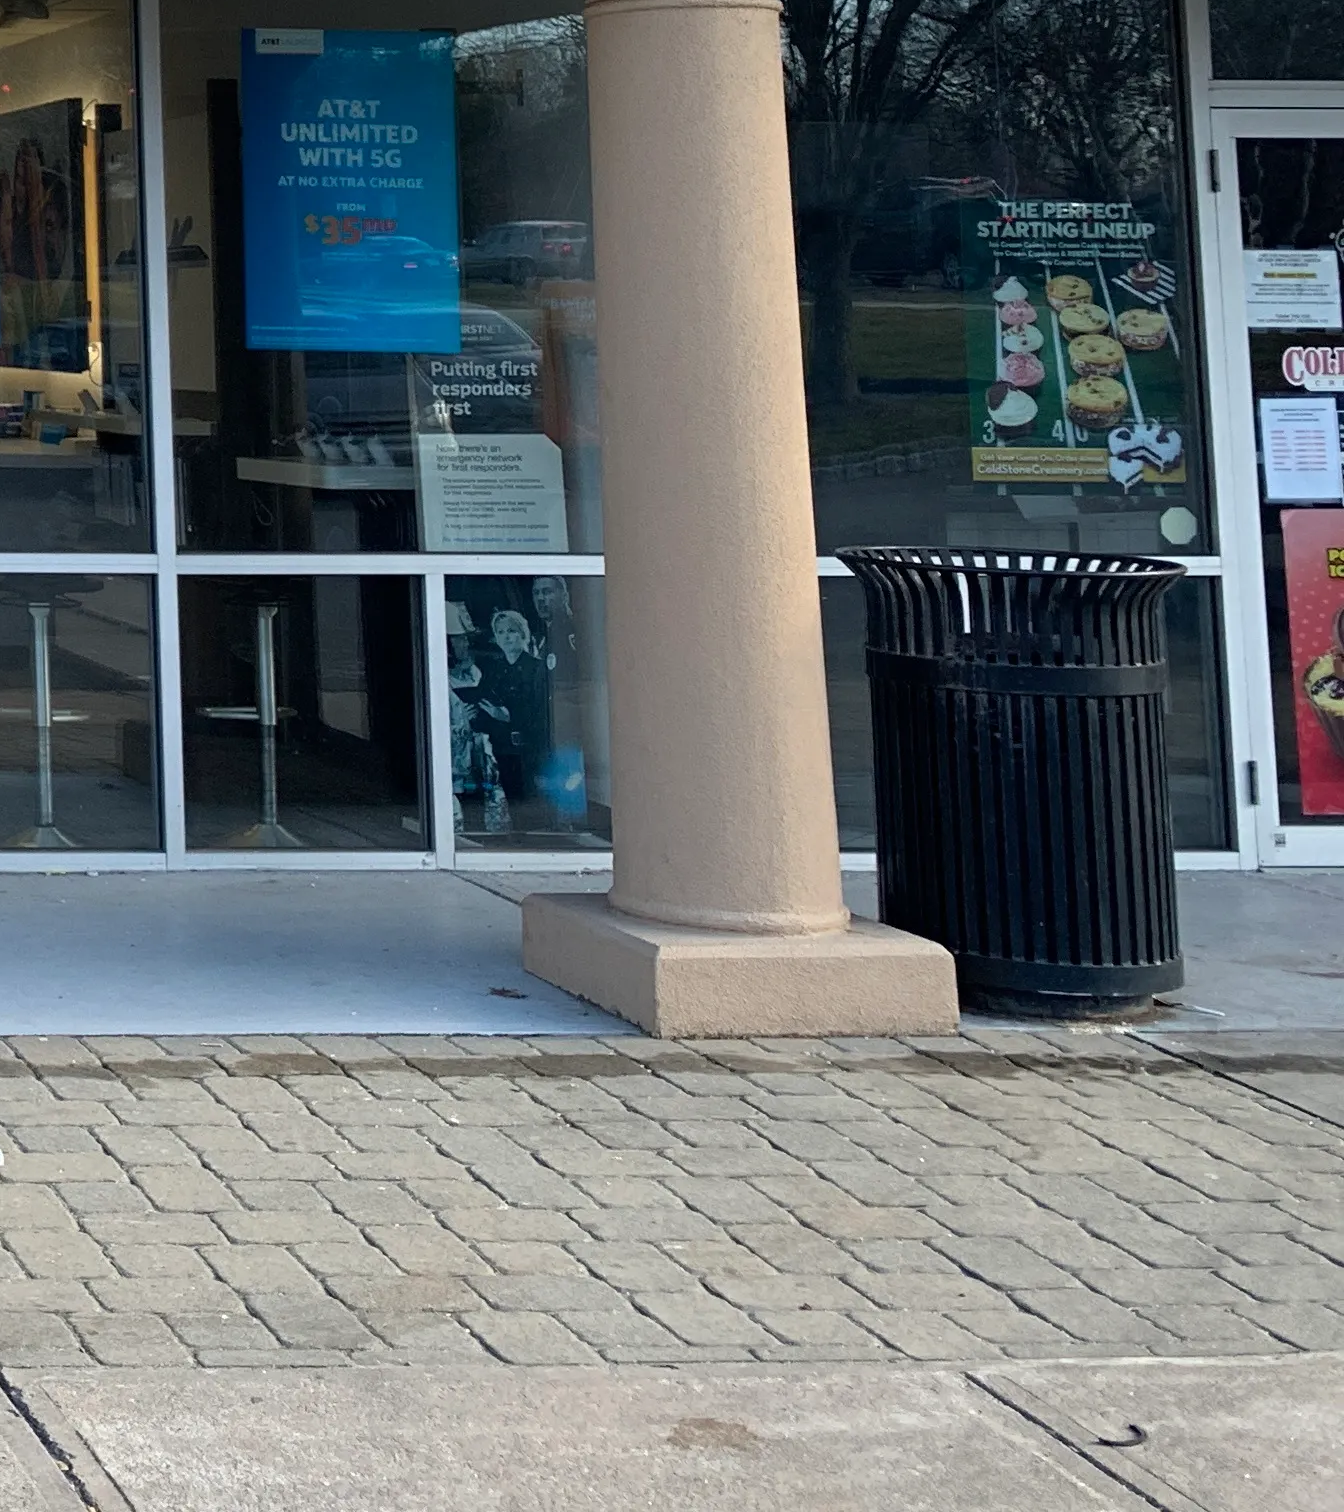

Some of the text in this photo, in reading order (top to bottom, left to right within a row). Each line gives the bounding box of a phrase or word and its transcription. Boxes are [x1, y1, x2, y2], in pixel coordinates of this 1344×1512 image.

[317, 98, 381, 119] AT&T
[280, 122, 419, 144] UNLIMITED
[298, 146, 402, 169] WITH 5G
[278, 175, 425, 189] AT NO EXTRA CHARGE
[1000, 201, 1132, 220] THE PERFECT
[977, 221, 1156, 240] STARTING LINEUP
[430, 360, 538, 379] Putting first
[432, 380, 532, 398] responders
[432, 399, 472, 416] first
[487, 454, 523, 462] network
